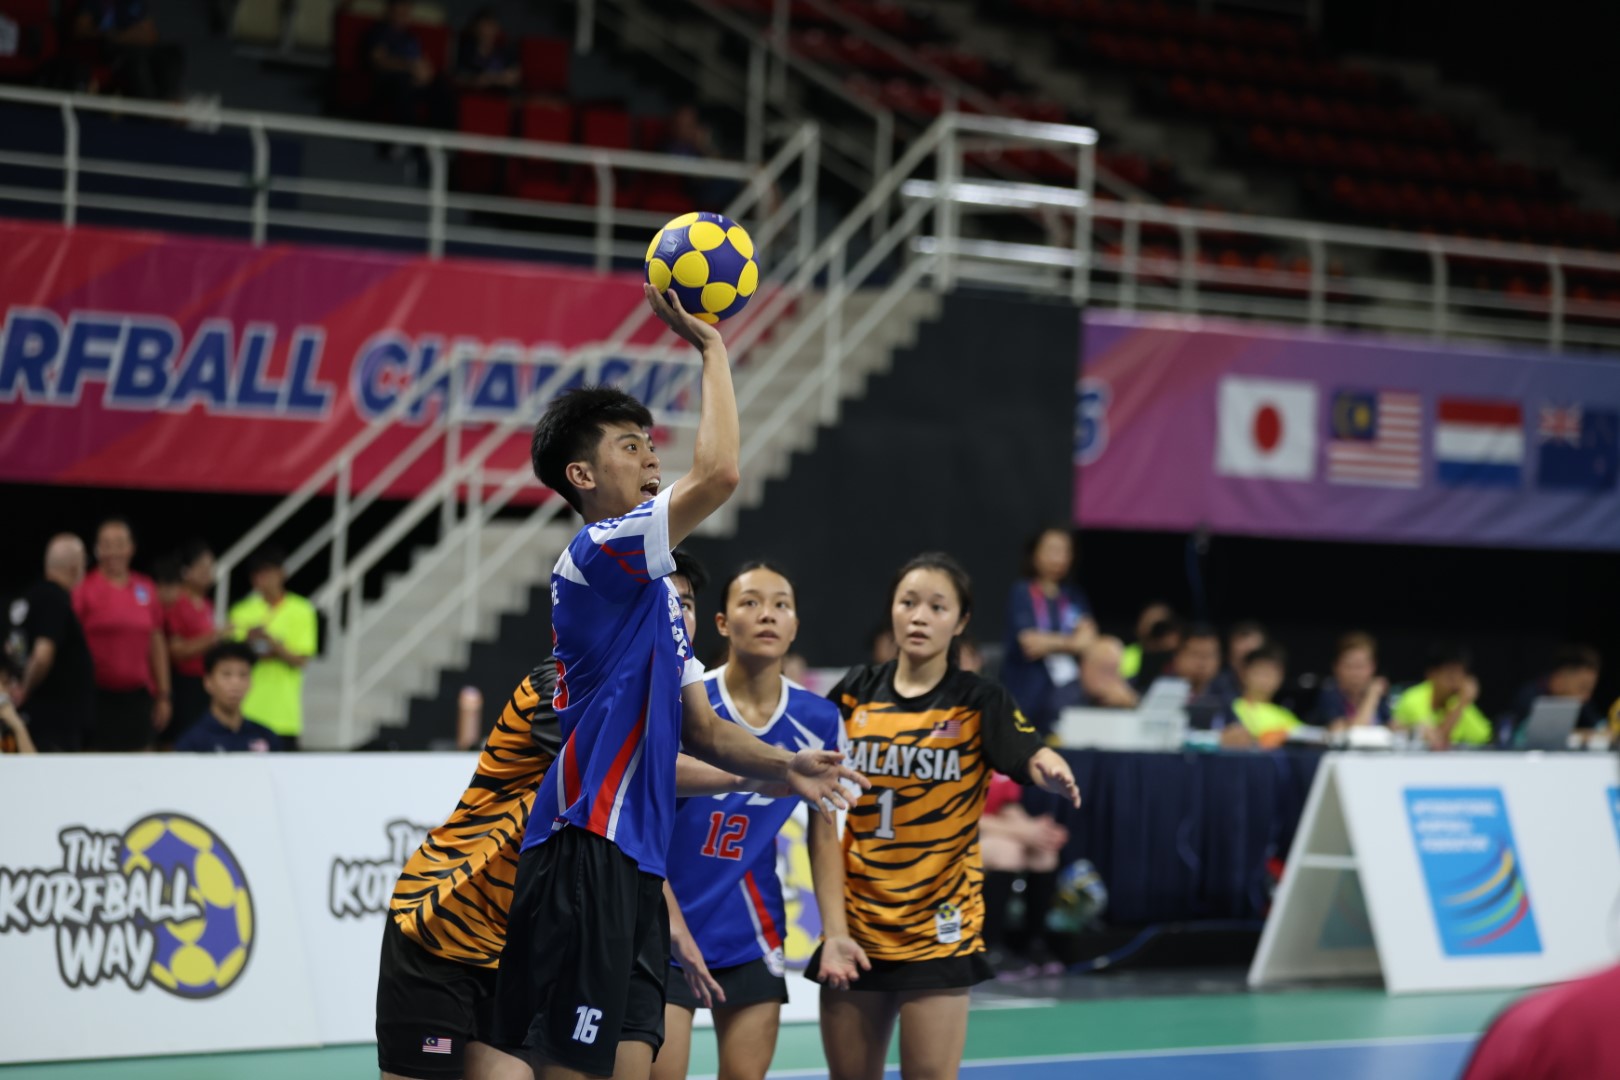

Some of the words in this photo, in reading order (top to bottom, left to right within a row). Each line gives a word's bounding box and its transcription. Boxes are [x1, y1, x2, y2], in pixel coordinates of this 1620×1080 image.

[700, 811, 750, 861] 12
[874, 788, 896, 840] 1
[59, 826, 122, 874] THE
[0, 865, 205, 932] KORFBALL
[57, 921, 155, 990] WAY
[571, 1005, 603, 1045] 16
